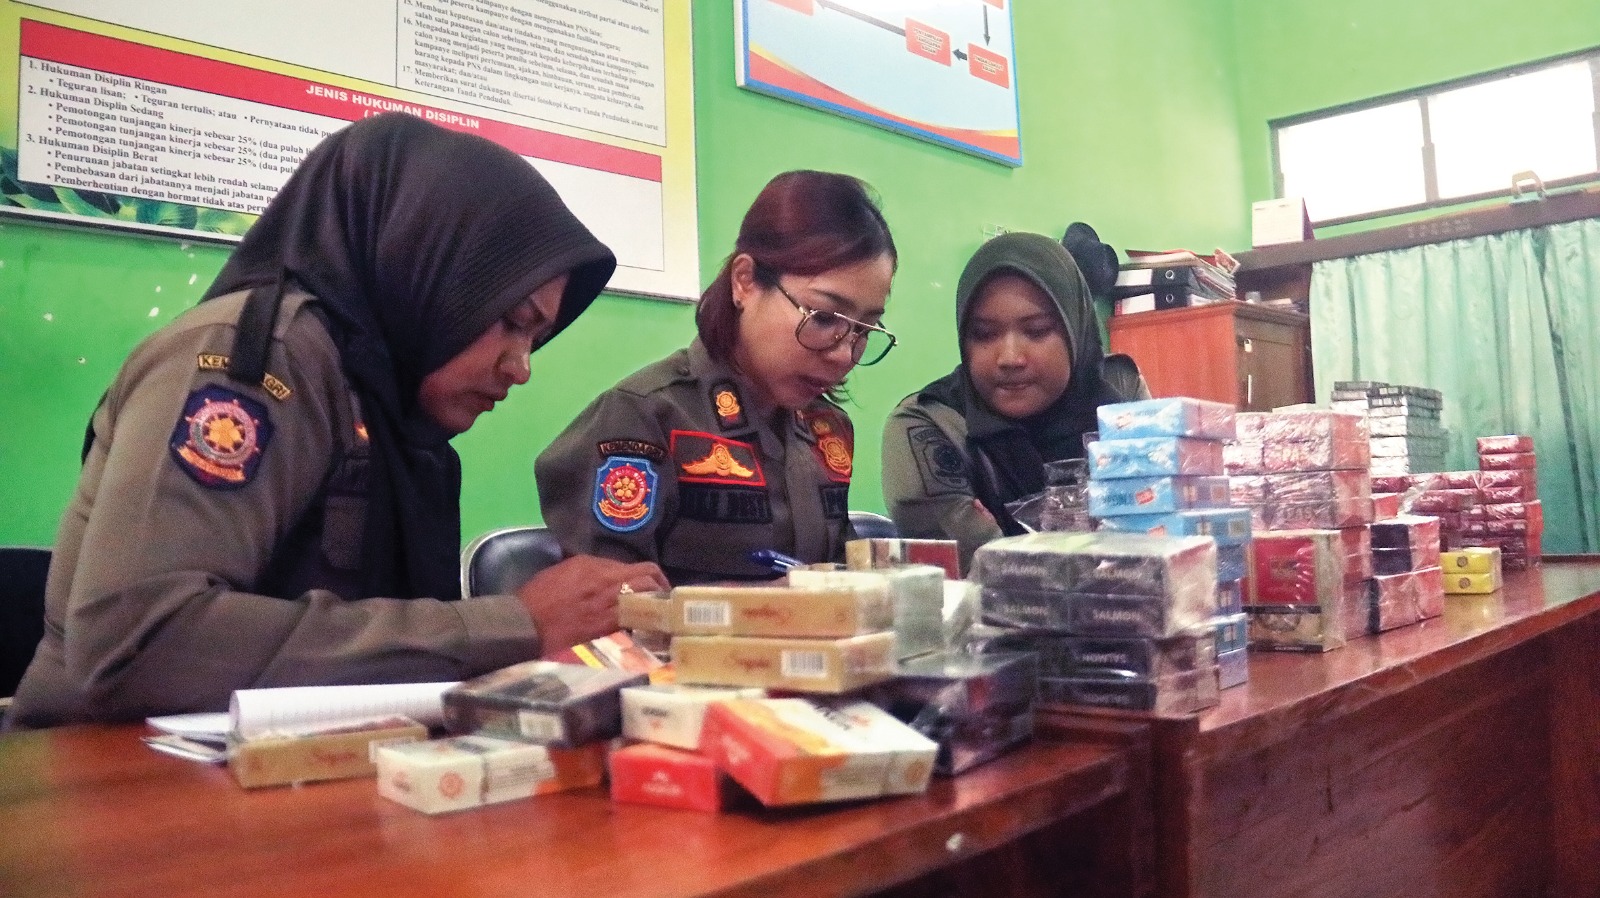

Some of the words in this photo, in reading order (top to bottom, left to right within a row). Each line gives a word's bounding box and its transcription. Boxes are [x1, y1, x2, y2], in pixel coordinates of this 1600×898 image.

[415, 11, 433, 20] salah
[434, 16, 448, 24] satu
[450, 21, 480, 32] pasangan
[482, 29, 500, 37] calon
[416, 1, 448, 15] Membuat
[450, 10, 483, 24] keputusan
[475, 4, 509, 20] kampanye
[403, 15, 413, 24] 16.
[415, 19, 459, 36] Mengadakan
[460, 31, 488, 44] kegiatan
[490, 40, 505, 50] yang
[414, 30, 433, 39] calon
[434, 35, 451, 45] yang
[452, 40, 480, 51] menjadi
[481, 47, 504, 57] peserta
[414, 38, 450, 54] kampanye
[452, 49, 479, 60] meliputi
[29, 60, 38, 69] 1.
[40, 62, 92, 79] Hukuman
[94, 72, 132, 87] Disiplin
[134, 80, 168, 94] Ringan
[414, 48, 439, 61] barang
[441, 54, 465, 66] kepada
[466, 60, 481, 70] PNS
[482, 64, 502, 75] dalam
[402, 64, 412, 73] 17.
[414, 68, 458, 83] Memberikan
[460, 80, 477, 88] surat
[478, 82, 511, 95] dukungan
[414, 78, 454, 92] Keterangan
[457, 87, 477, 97] Tanda
[27, 84, 36, 94] 2.
[40, 87, 91, 104] Hukuman
[94, 97, 128, 111] Displin
[130, 104, 164, 120] Sedang
[56, 78, 98, 93] Teguran
[100, 86, 126, 101] lisan;
[142, 94, 178, 109] Teguran
[181, 103, 216, 117] tertulis;
[218, 110, 237, 119] atau
[250, 115, 296, 130] Pernyataan
[298, 124, 319, 135] tidak
[306, 86, 348, 101] JENIS
[352, 96, 422, 116] HUKUMAN
[426, 111, 480, 128] DISIPLIN
[55, 114, 116, 132] Pemotongan
[119, 126, 166, 141] tunjangan
[169, 134, 201, 148] kinerja
[203, 141, 235, 153] sebesar
[238, 146, 257, 156] 25%
[259, 149, 278, 160] (dua
[56, 102, 116, 120] Pemotongan
[119, 114, 166, 129] tunjangan
[169, 122, 201, 136] kinerja
[204, 130, 235, 141] sebesar
[238, 134, 257, 145] 25%
[259, 138, 278, 149] (dua
[280, 143, 304, 153] puluh
[26, 132, 35, 142] 3.
[38, 134, 90, 151] Hukuman
[92, 143, 130, 157] Disiplin
[132, 150, 158, 162] Berat
[55, 126, 116, 144] Pemotongan
[118, 138, 166, 153] tunjangan
[168, 145, 201, 160] kinerja
[203, 153, 235, 164] sebesar
[237, 157, 257, 167] 25%
[259, 160, 278, 170] (dua
[54, 149, 109, 166] Penurunan
[112, 158, 148, 172] jabatan
[151, 167, 192, 179] setingkat
[194, 171, 215, 182] lebih
[218, 177, 248, 187] rendah
[250, 181, 278, 192] selama
[54, 161, 116, 178] Pembebasan
[118, 171, 138, 182] dari
[140, 174, 192, 191] jabatannya
[194, 185, 230, 196] menjadi
[231, 188, 264, 200] jabatan
[54, 173, 129, 192] Pemberhentian
[131, 185, 164, 198] dengan
[167, 190, 200, 203] hormat
[202, 196, 225, 206] tidak
[227, 201, 244, 209] atas
